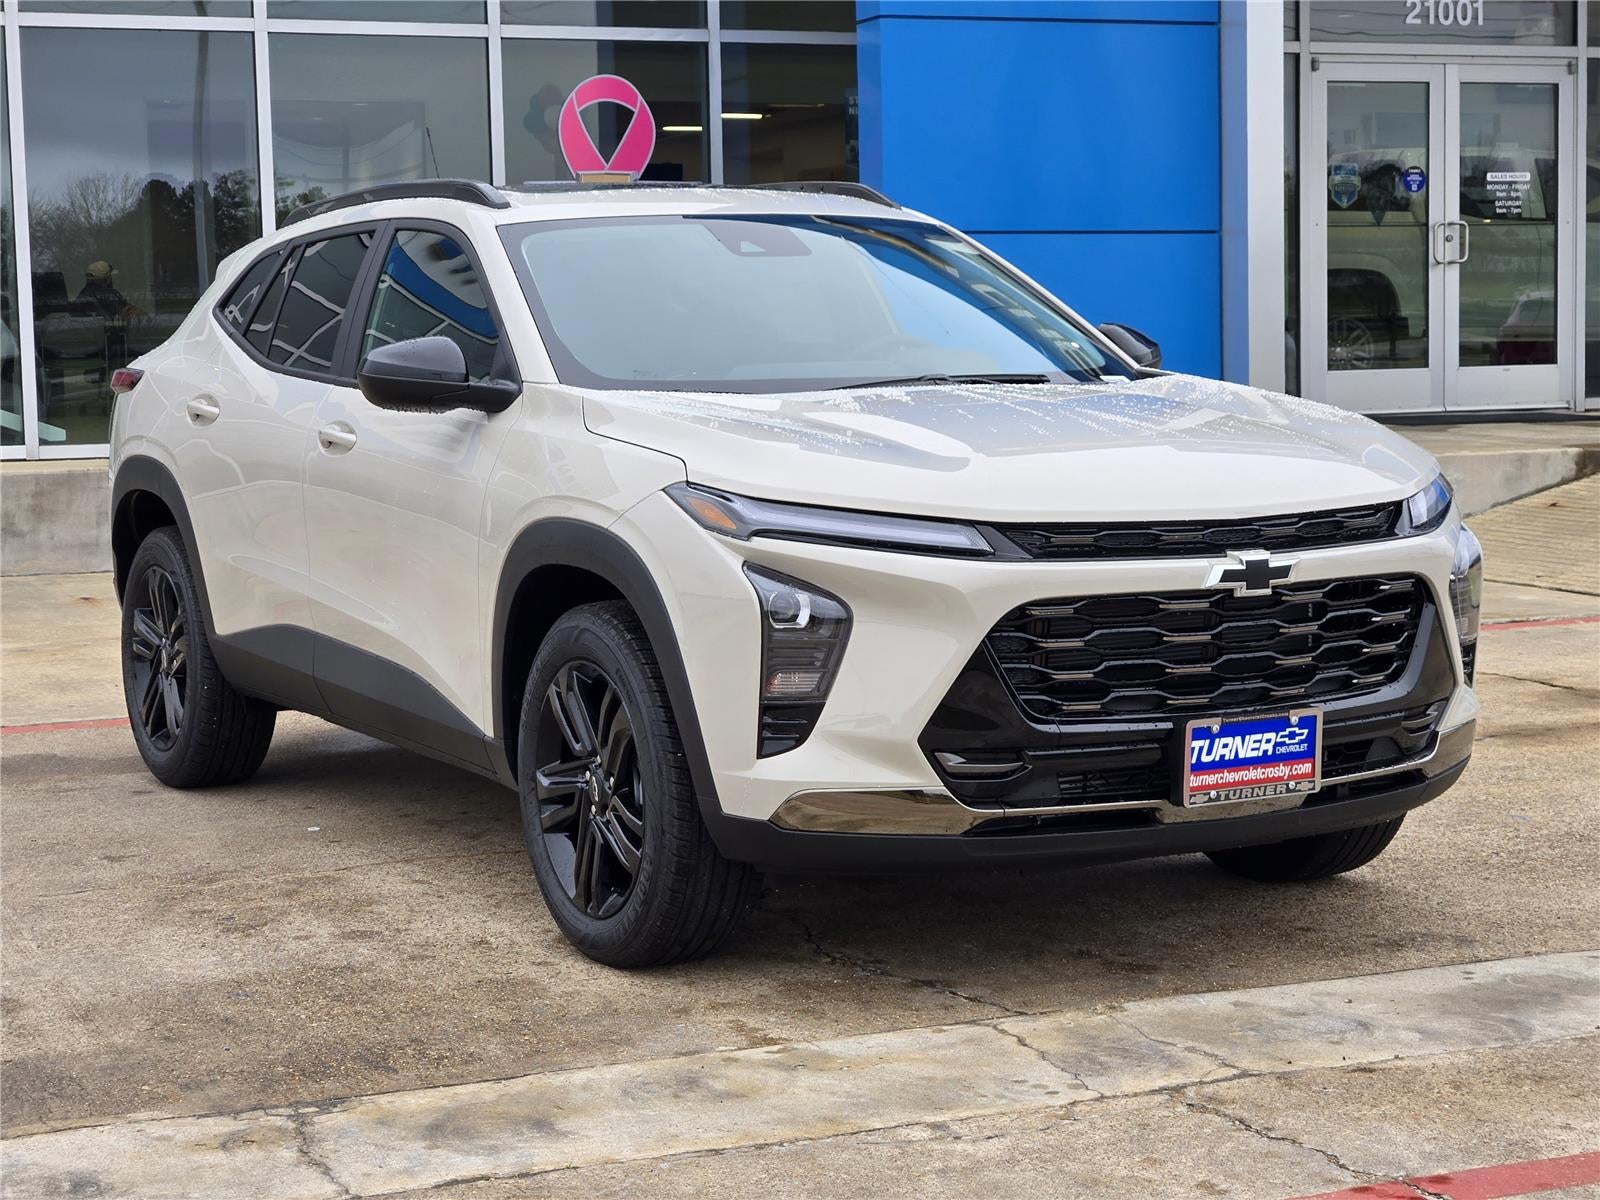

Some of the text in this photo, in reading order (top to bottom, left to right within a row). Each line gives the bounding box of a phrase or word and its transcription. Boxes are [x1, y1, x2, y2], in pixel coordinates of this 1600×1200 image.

[1405, 0, 1484, 26] 21001
[1191, 732, 1277, 764] TURNER
[1276, 743, 1308, 754] CHEVROLET
[1189, 762, 1312, 787] turnerchevroletcrosby.com
[1218, 784, 1287, 801] TURNER
